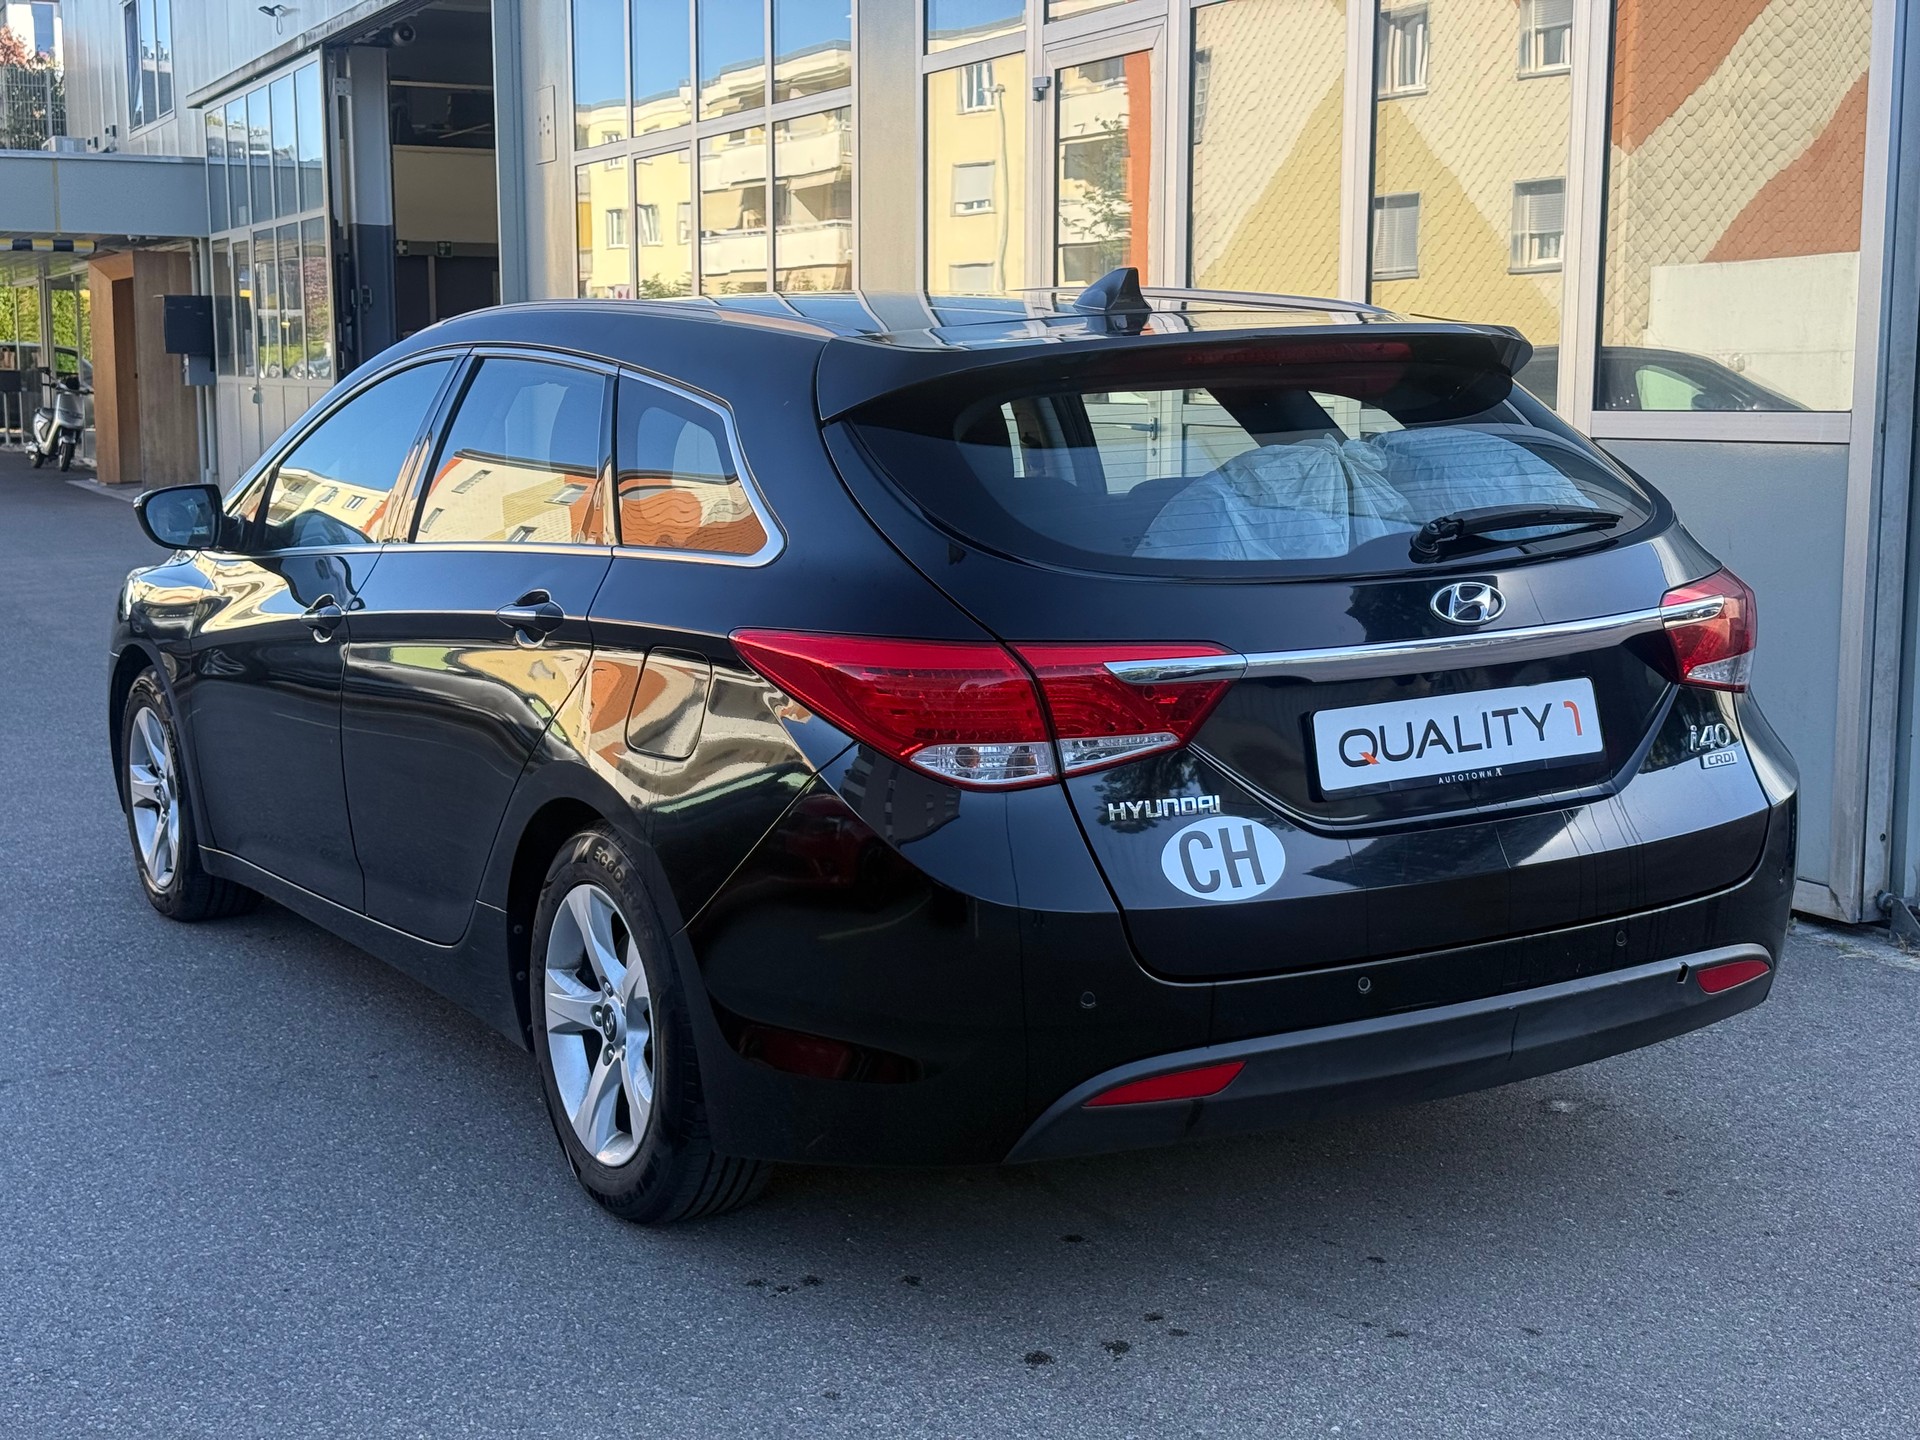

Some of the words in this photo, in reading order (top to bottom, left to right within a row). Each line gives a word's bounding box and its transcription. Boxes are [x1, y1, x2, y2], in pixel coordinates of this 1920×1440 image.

[1338, 703, 1552, 767] QUALITY
[1689, 723, 1731, 753] i40
[1438, 770, 1493, 785] AUTOTOWN
[1107, 795, 1220, 822] HYUNDAI
[1179, 825, 1267, 893] CH
